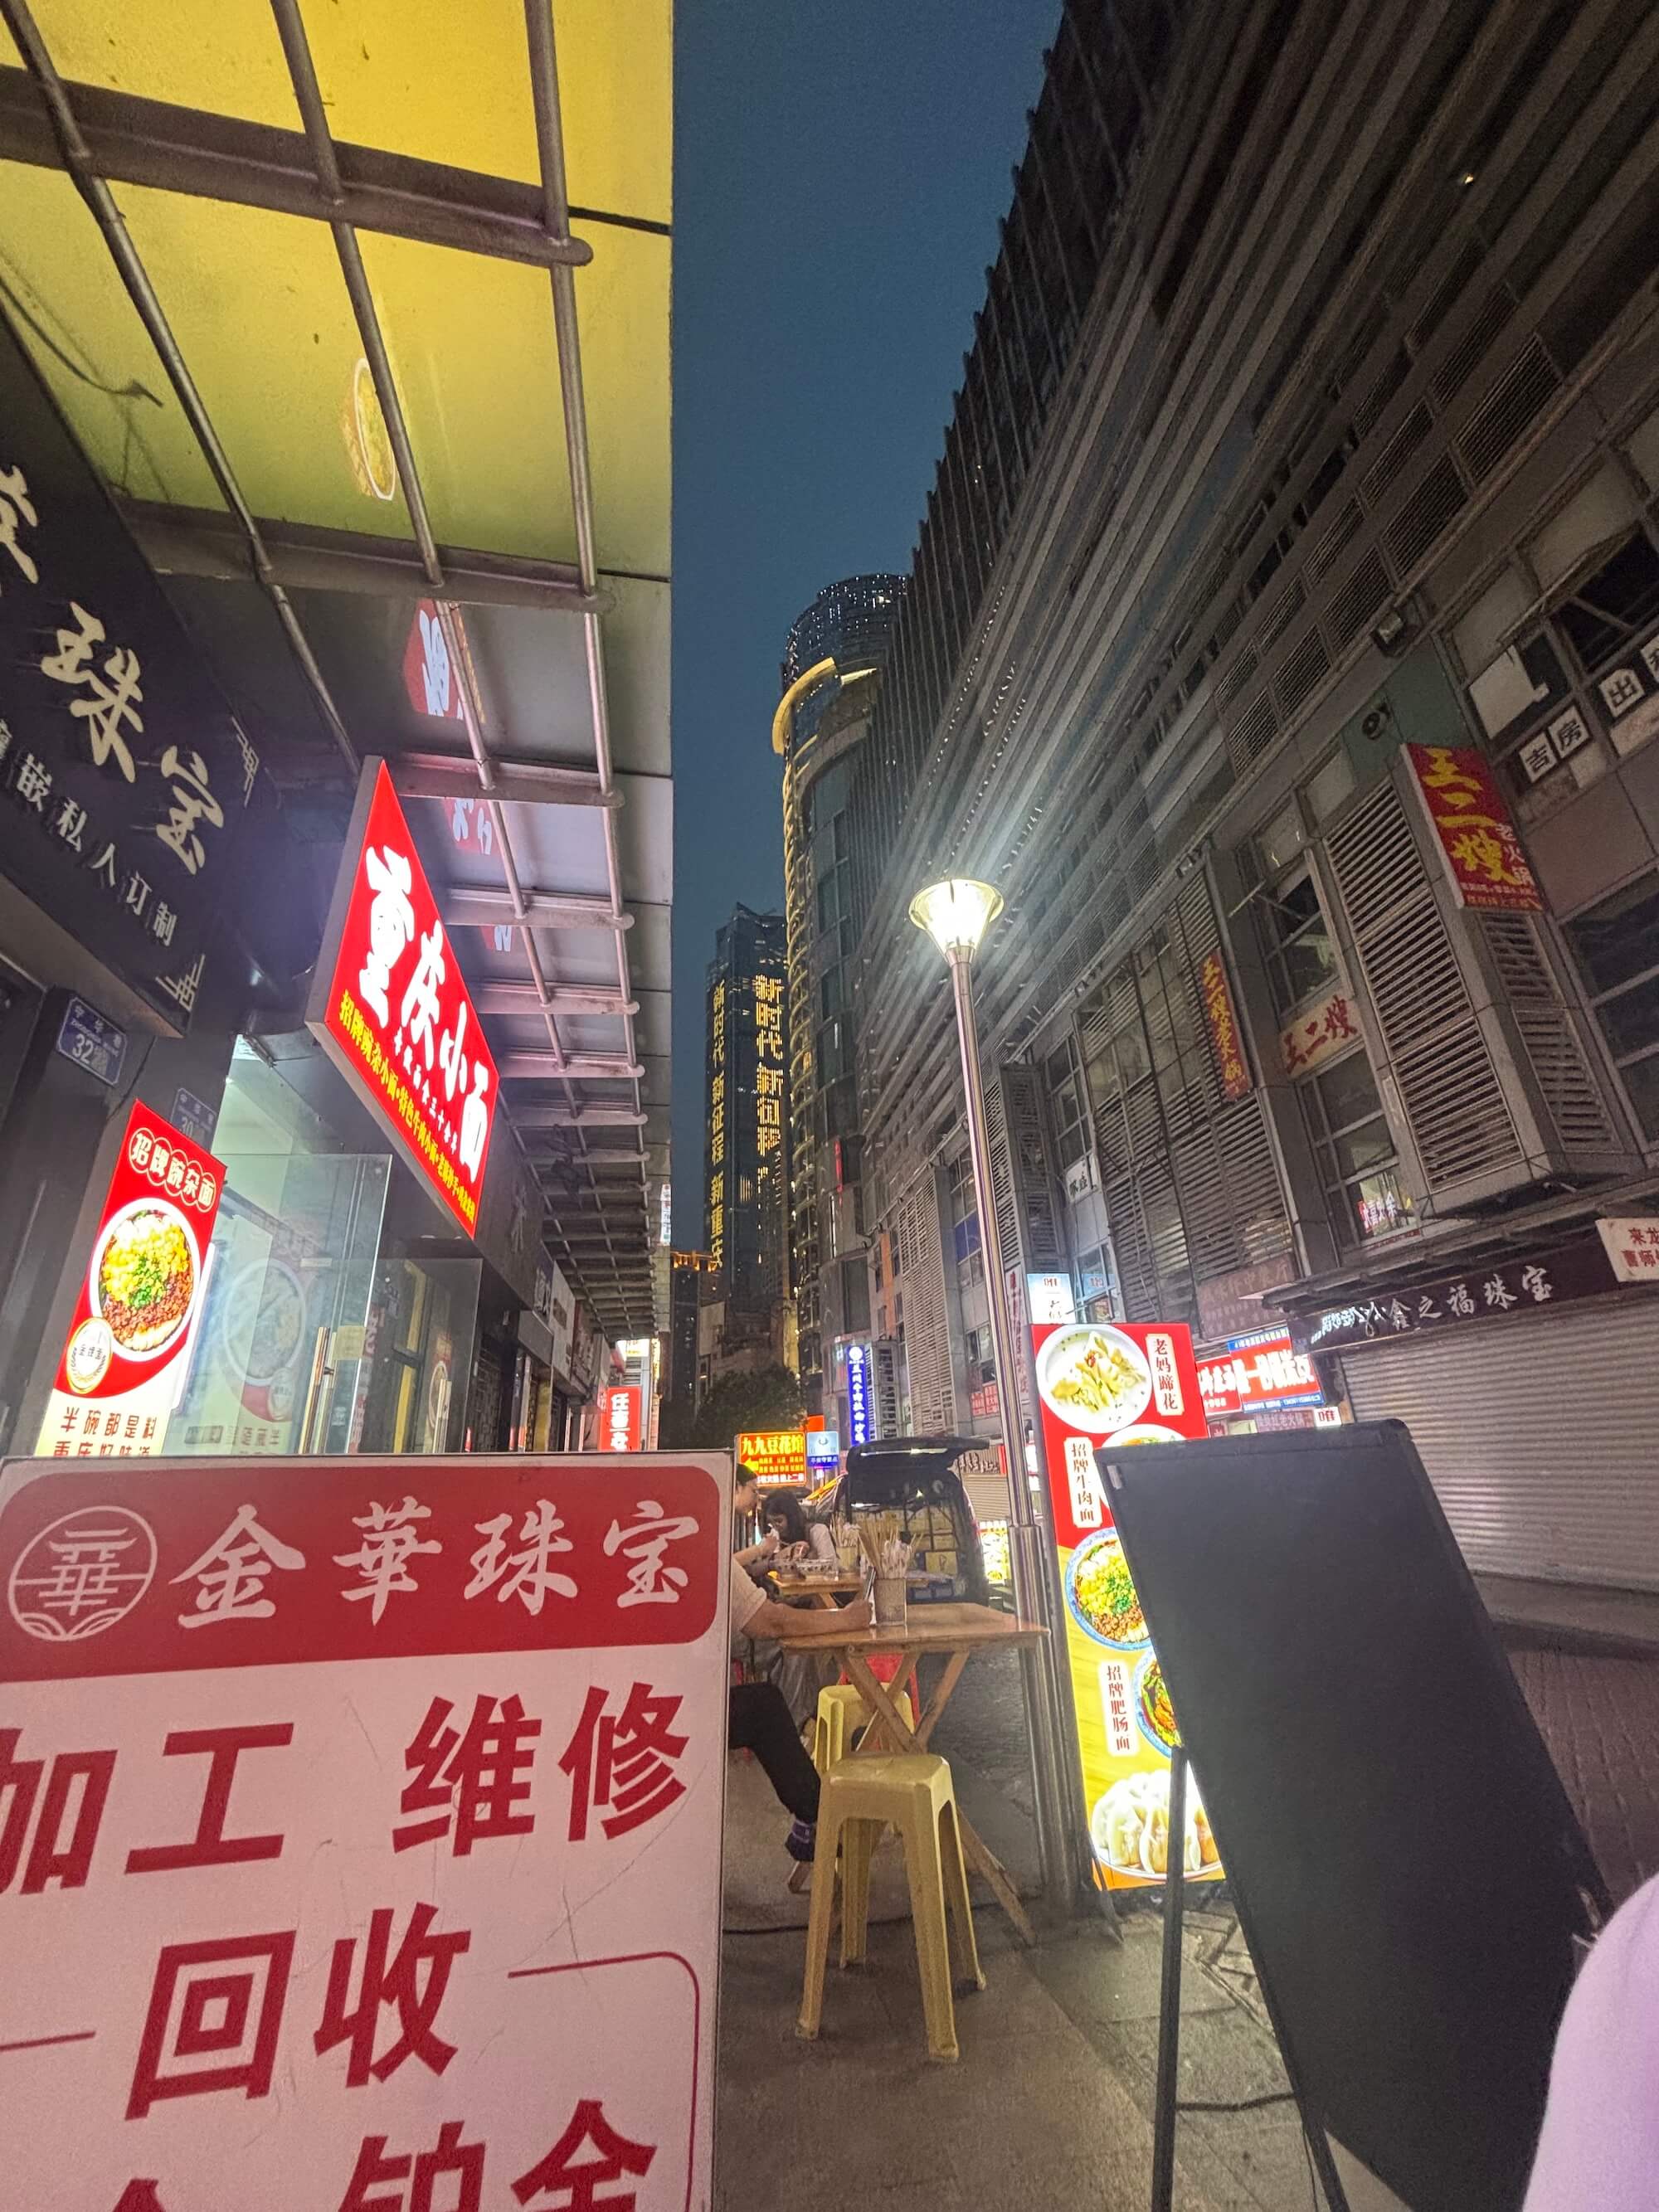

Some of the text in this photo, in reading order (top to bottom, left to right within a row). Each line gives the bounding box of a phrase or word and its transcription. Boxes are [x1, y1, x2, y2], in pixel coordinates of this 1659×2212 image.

[72, 1033, 94, 1064] 32
[359, 844, 489, 1183] 重庆小面
[752, 974, 784, 1060] 新时代
[1154, 1338, 1178, 1410] 老妈蹄花
[742, 1435, 804, 1456] 九九豆花馆
[1071, 1443, 1095, 1523] 招牌牛肉面
[1107, 1665, 1130, 1750] 招牌肥肠面
[0, 1682, 688, 1894] 加工 维修
[124, 1902, 471, 2121] 回收
